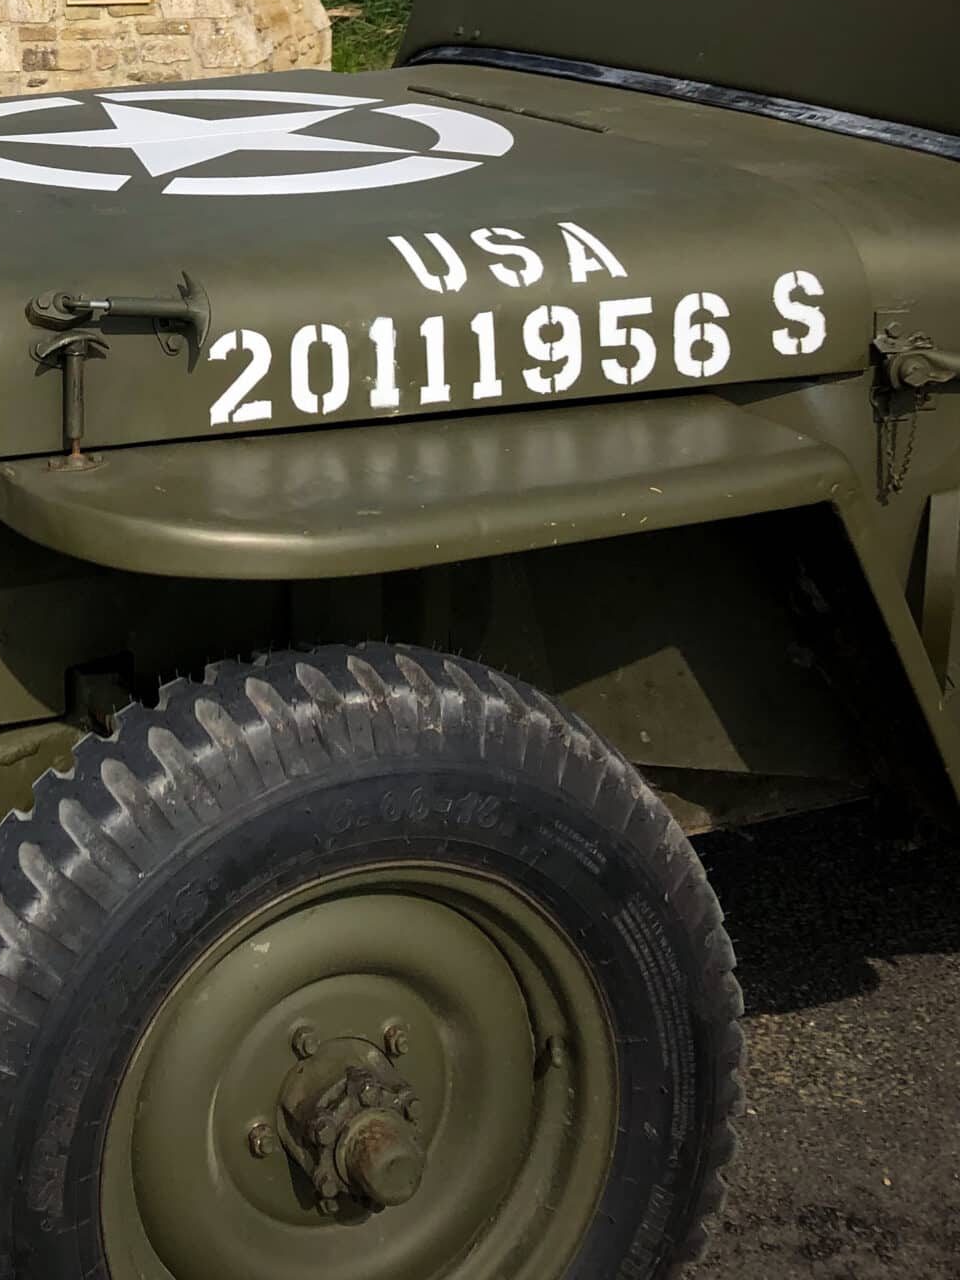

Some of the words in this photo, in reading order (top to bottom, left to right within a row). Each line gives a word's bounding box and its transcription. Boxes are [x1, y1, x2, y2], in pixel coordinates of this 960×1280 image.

[388, 222, 628, 295] USA
[207, 292, 731, 427] 20111956
[772, 270, 827, 355] S
